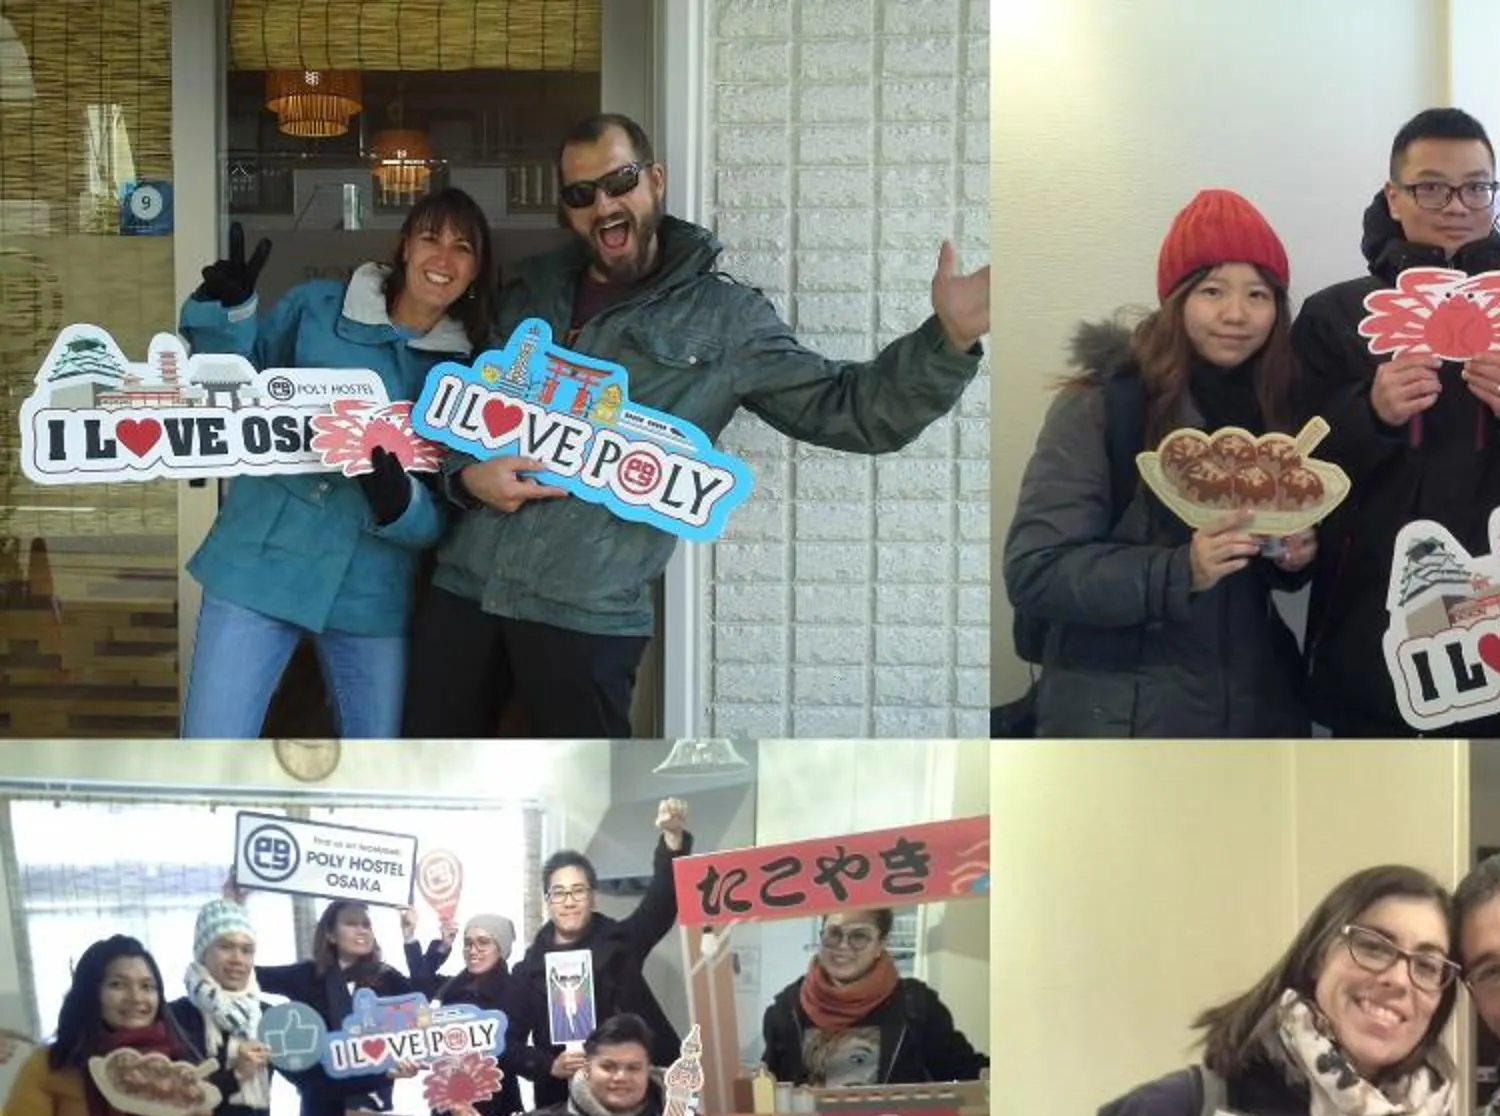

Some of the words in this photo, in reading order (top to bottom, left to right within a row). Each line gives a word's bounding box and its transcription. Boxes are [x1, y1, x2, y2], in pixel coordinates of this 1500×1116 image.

[297, 384, 328, 395] POLY
[332, 383, 374, 395] HOSTEL
[434, 383, 454, 419] I
[48, 420, 67, 461] I
[1411, 651, 1440, 702] I
[306, 850, 345, 870] POLY
[349, 855, 405, 877] HOSTEL
[696, 836, 931, 916] たこやき
[326, 872, 382, 893] OSAKA
[335, 1044, 342, 1067] I
